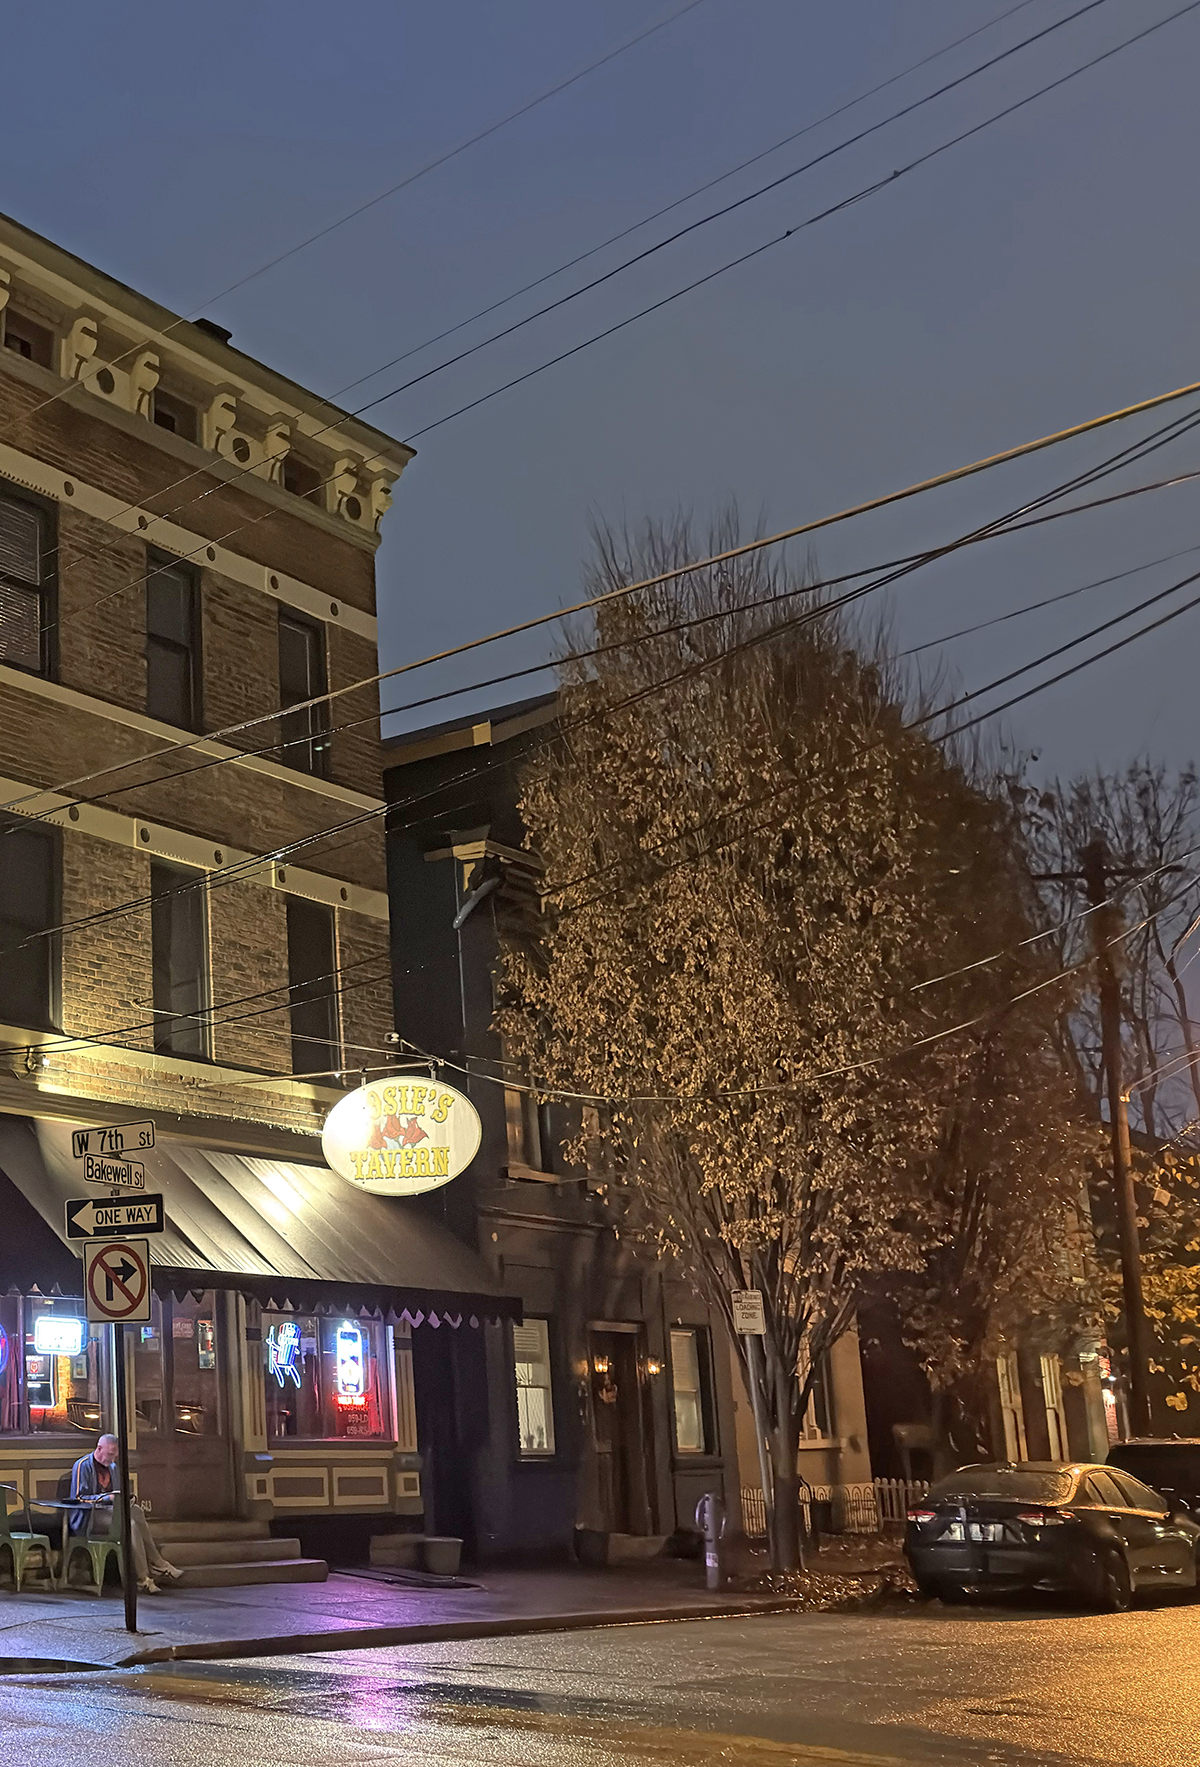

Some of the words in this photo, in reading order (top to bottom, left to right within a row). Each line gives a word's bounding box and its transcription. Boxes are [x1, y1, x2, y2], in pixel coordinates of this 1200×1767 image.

[366, 1085, 455, 1123] OSIE'S
[76, 1132, 90, 1155] W
[97, 1129, 124, 1151] 7th
[139, 1131, 151, 1147] St
[86, 1156, 133, 1185] Bakewell
[134, 1171, 143, 1187] St
[349, 1146, 451, 1180] TAVERN
[95, 1208, 122, 1225] ONE
[126, 1206, 153, 1223] WAY
